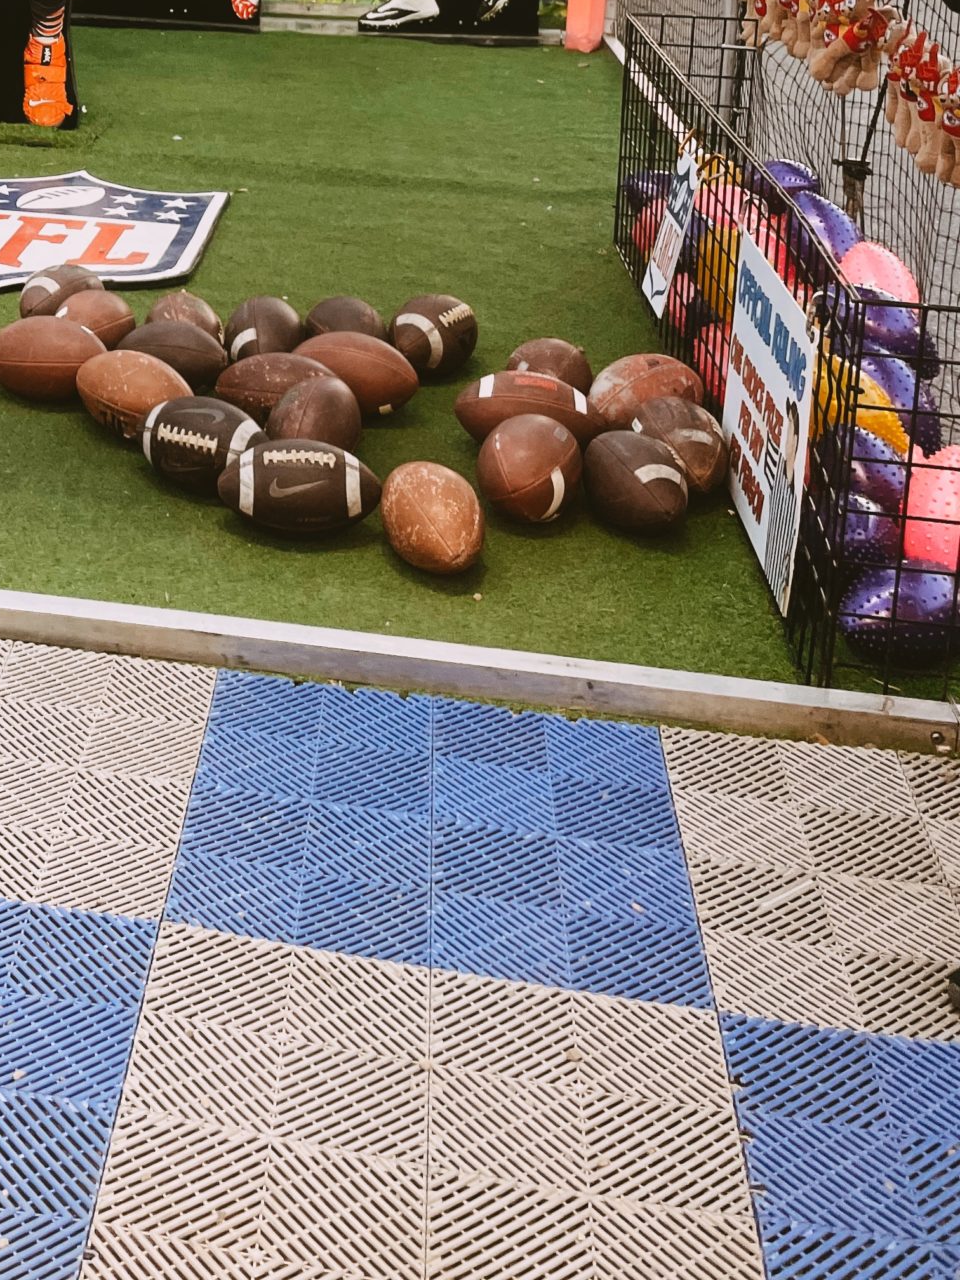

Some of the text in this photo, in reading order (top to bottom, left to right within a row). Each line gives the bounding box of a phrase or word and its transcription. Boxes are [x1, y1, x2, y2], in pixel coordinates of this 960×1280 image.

[739, 260, 807, 402] OFFICIAL RULING
[730, 332, 784, 449] ONE CHOICE PRIZE
[738, 400, 765, 467] PER DAY
[729, 432, 765, 526] PER PERSON
